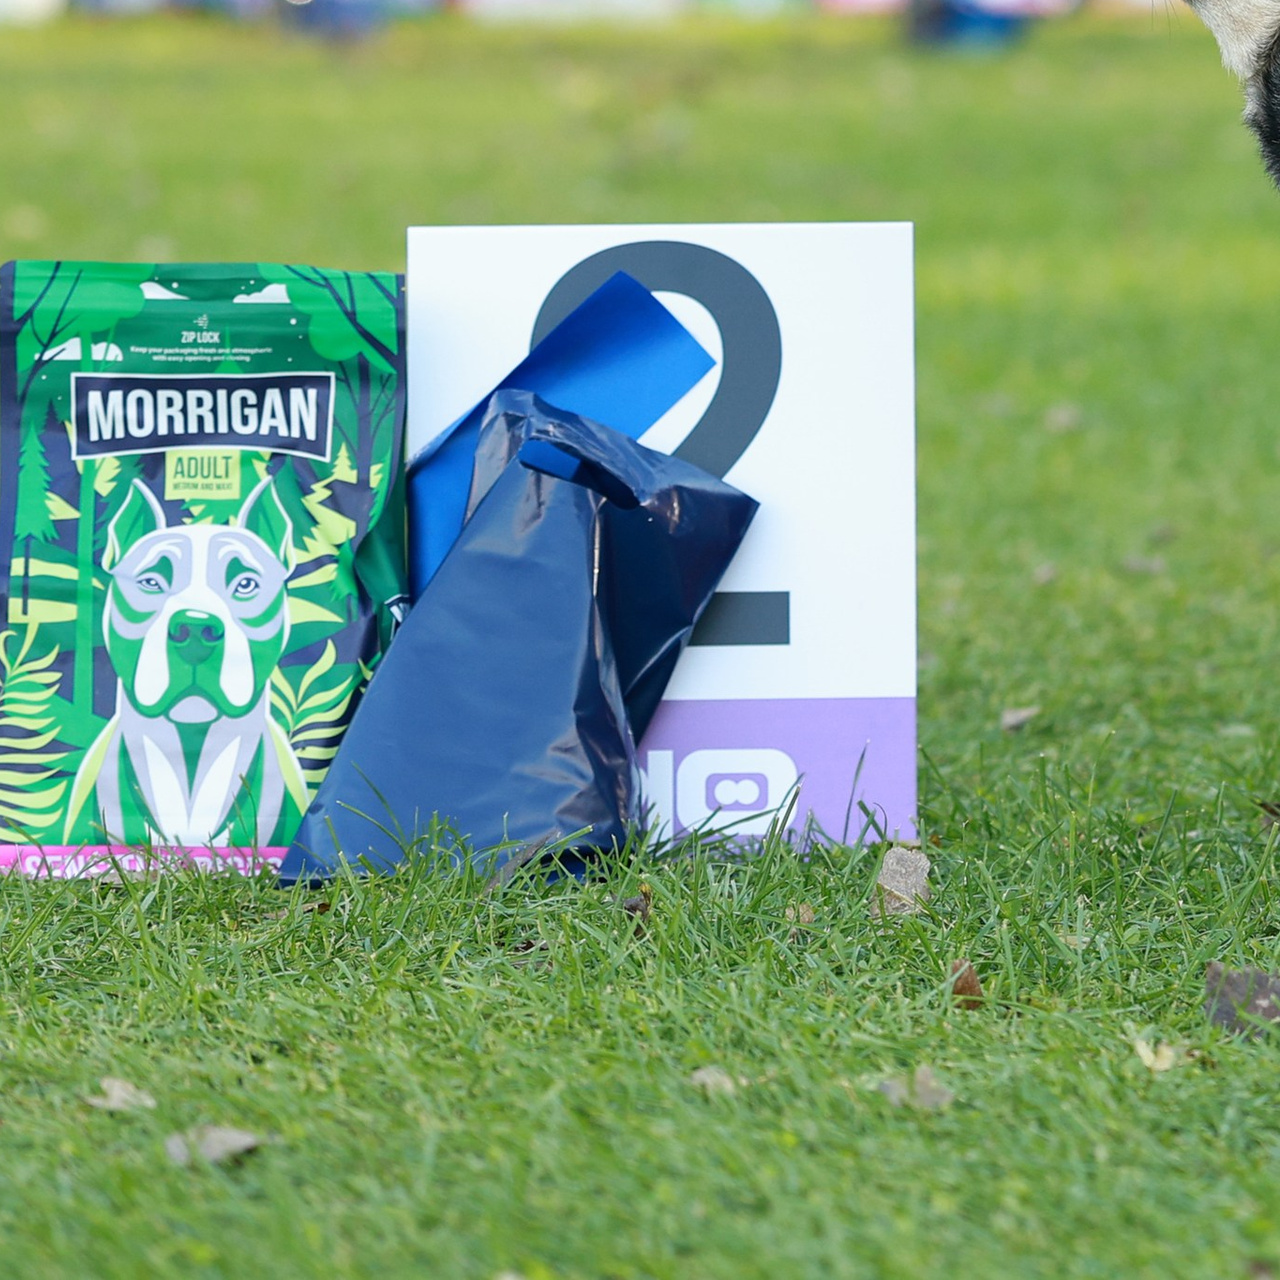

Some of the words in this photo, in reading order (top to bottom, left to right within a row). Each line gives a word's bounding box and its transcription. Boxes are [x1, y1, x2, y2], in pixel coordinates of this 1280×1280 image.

[181, 331, 196, 343] ZIP
[197, 331, 220, 343] LOCK
[163, 347, 198, 355] packaging
[87, 387, 318, 442] MORRIGAN
[173, 456, 233, 479] ADULT
